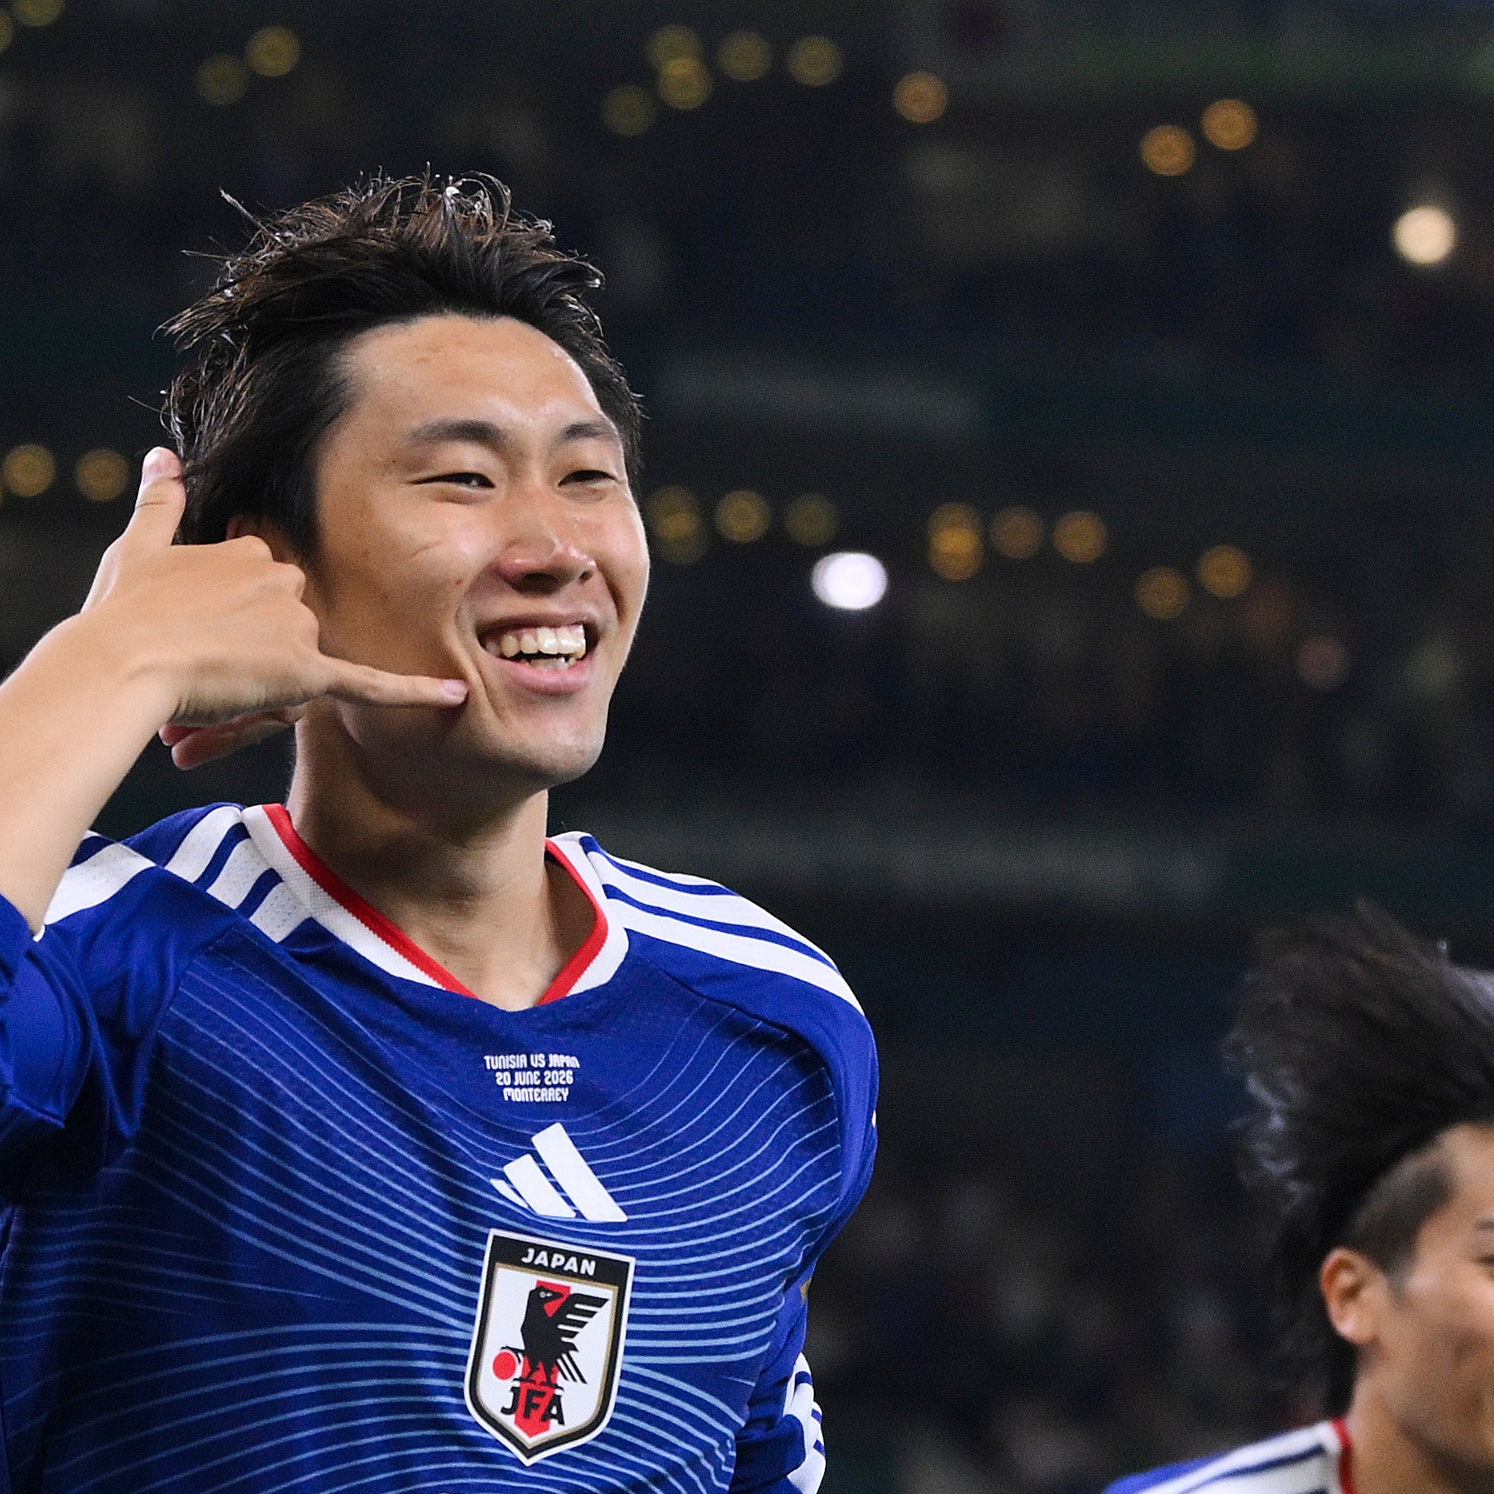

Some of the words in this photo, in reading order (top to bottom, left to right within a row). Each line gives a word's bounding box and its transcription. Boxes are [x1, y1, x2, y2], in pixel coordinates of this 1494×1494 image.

[483, 1054, 528, 1070] TUNISIA
[548, 1053, 580, 1069] JAPAN
[495, 1071, 511, 1086] 20
[513, 1070, 541, 1086] JUNE
[543, 1069, 574, 1085] 2026
[502, 1087, 569, 1102] MONTERREY
[521, 1247, 597, 1276] JAPAN
[500, 1385, 565, 1426] JFA
